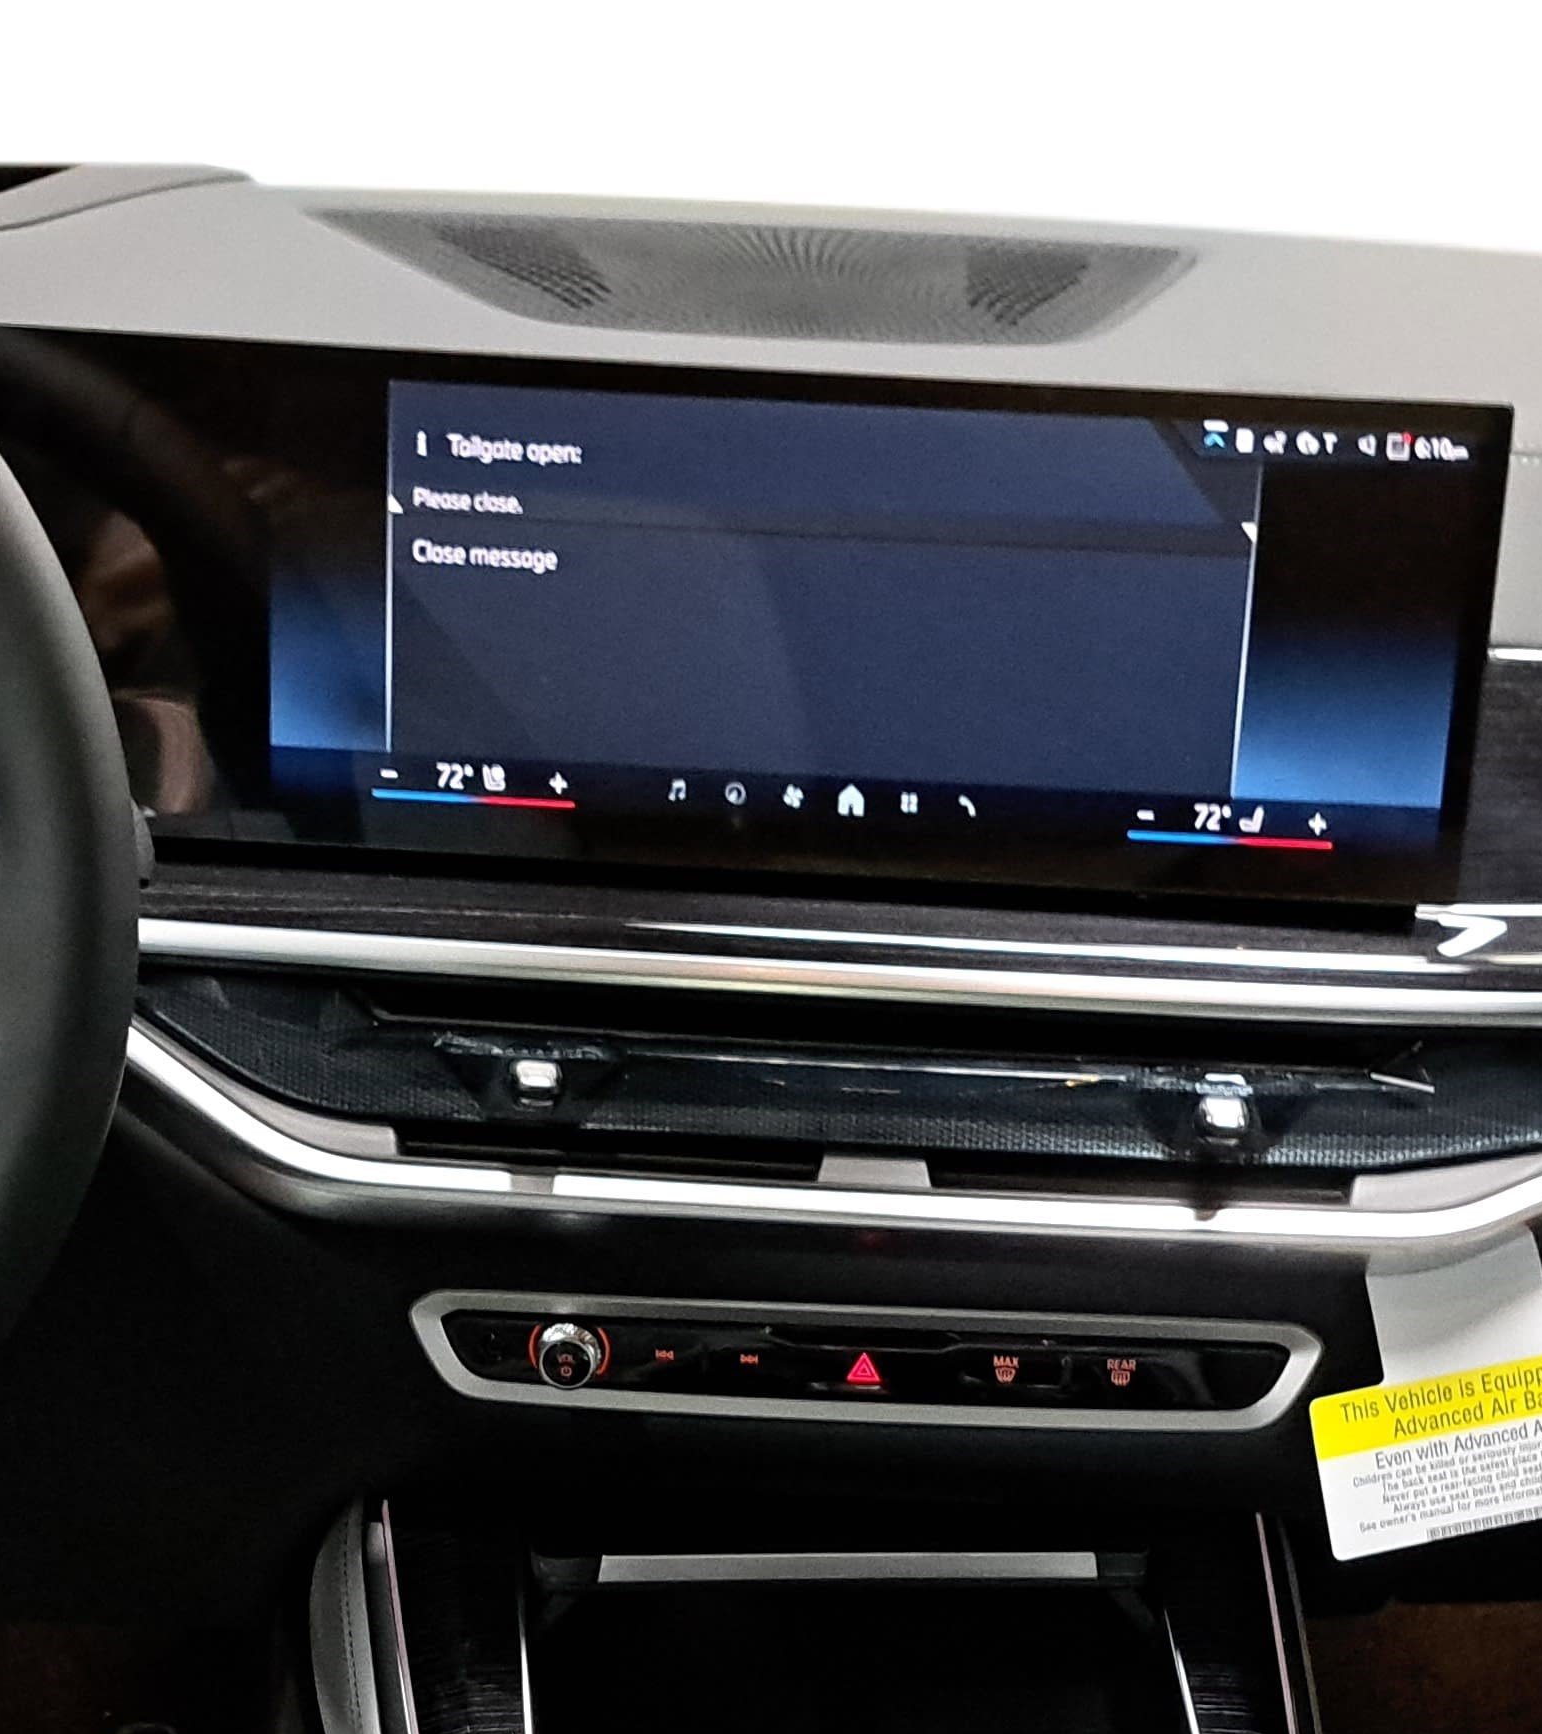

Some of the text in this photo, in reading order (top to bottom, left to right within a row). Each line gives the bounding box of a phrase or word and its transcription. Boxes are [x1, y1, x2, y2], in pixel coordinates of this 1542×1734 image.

[445, 432, 524, 464] Tailgate
[413, 486, 471, 512] Please
[412, 538, 559, 575] Close message
[993, 1355, 1019, 1369] MAX
[1107, 1358, 1137, 1371] REAR
[1340, 1398, 1379, 1423] This
[1384, 1384, 1452, 1413] Vehicle
[1394, 1401, 1484, 1439] Advanced
[1492, 1398, 1517, 1417] Air
[1375, 1451, 1412, 1470] Even
[1416, 1440, 1448, 1461] with
[1454, 1422, 1528, 1453] Advanced
